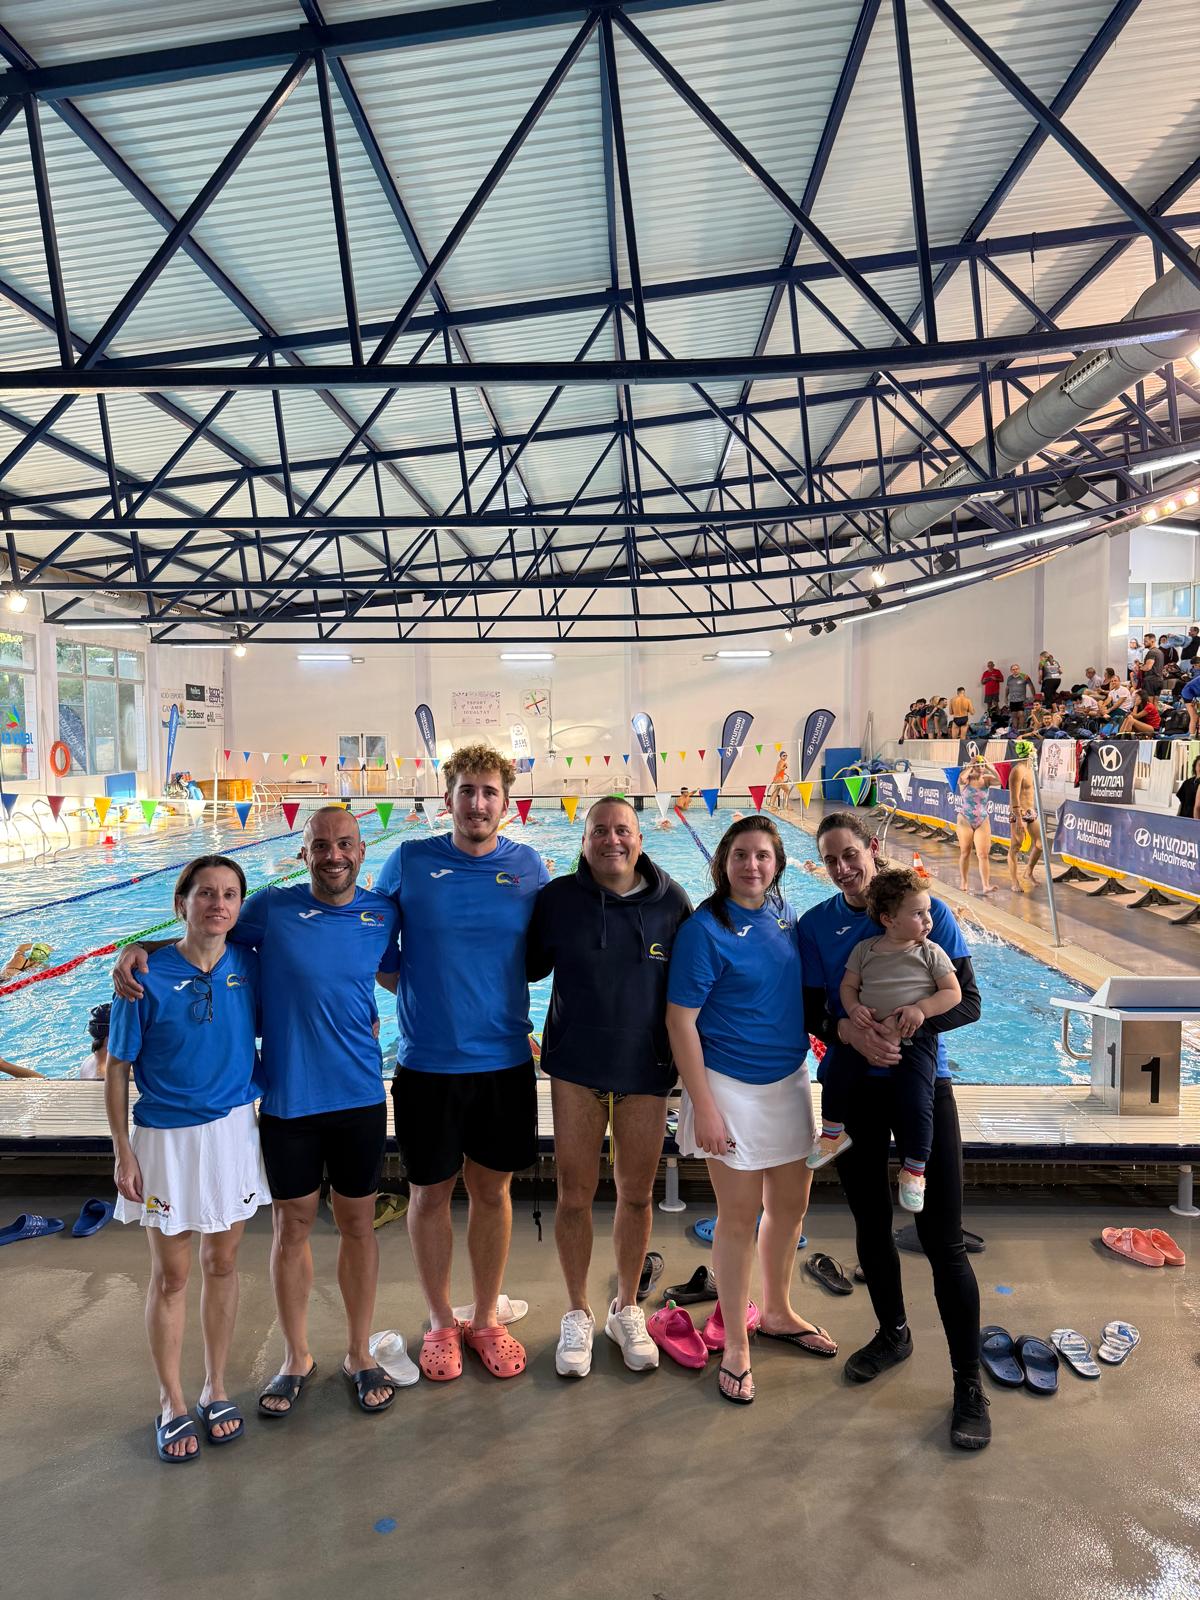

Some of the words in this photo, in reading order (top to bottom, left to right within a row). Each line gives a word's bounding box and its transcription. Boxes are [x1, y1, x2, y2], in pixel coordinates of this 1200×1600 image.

[729, 716, 743, 746] HYUNDAI
[811, 715, 824, 745] HYUNDAI
[1090, 788, 1124, 798] Autoalmenar
[1091, 775, 1124, 788] HYUNDAI
[1077, 818, 1112, 837] HYUNDAI
[1076, 832, 1111, 849] Autoalmenar
[1152, 833, 1199, 859] HYUNDAI
[1152, 849, 1197, 871] Autoalmenar
[1107, 1042, 1116, 1089] 1
[1141, 1057, 1160, 1104] 1
